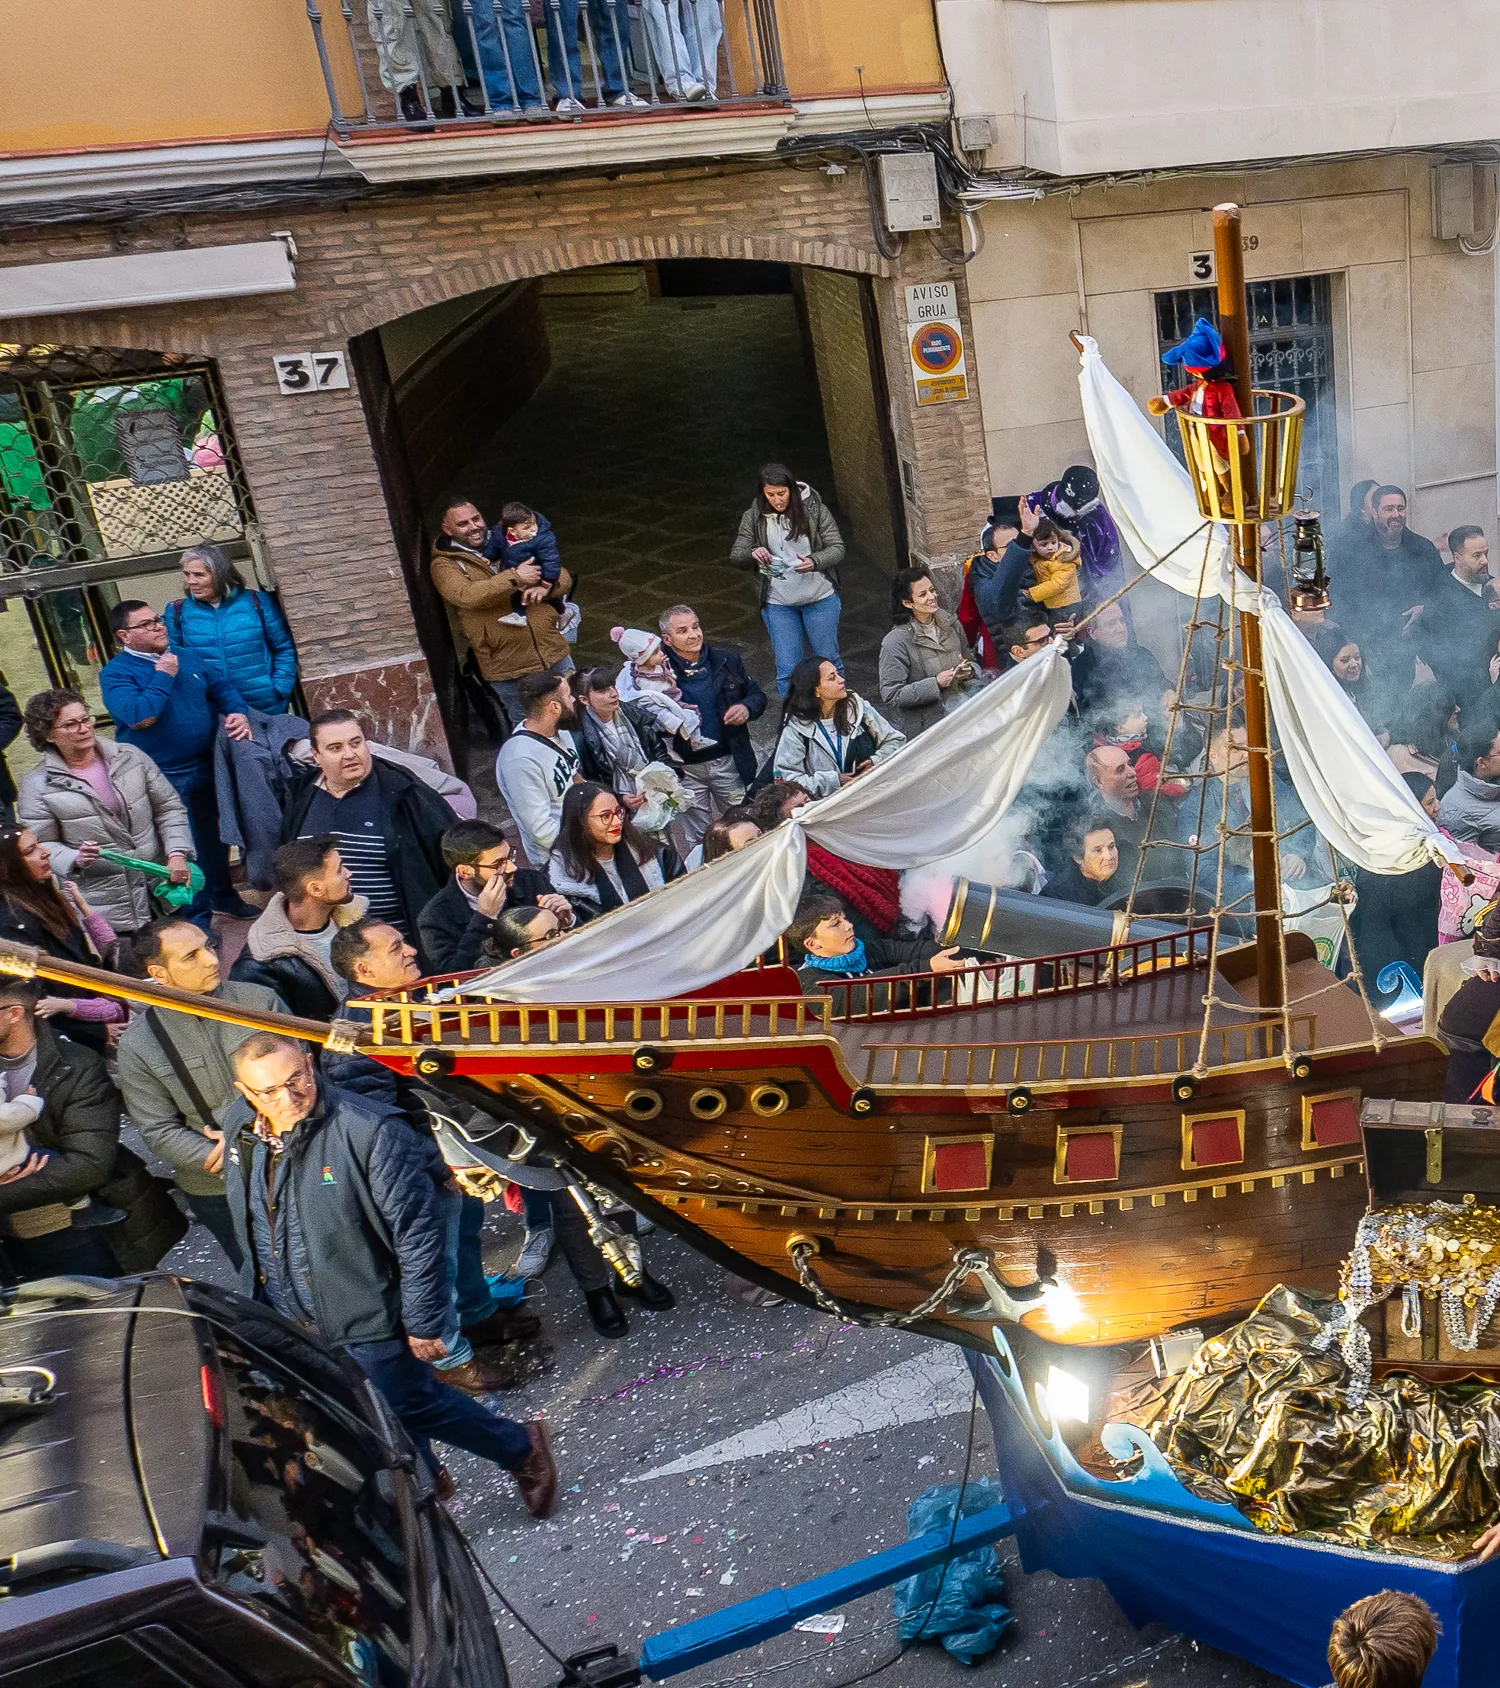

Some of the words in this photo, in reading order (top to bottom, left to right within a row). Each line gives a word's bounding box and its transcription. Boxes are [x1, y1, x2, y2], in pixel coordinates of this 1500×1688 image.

[912, 284, 949, 301] AVISO
[917, 303, 947, 318] GRUA
[278, 357, 339, 388] 37
